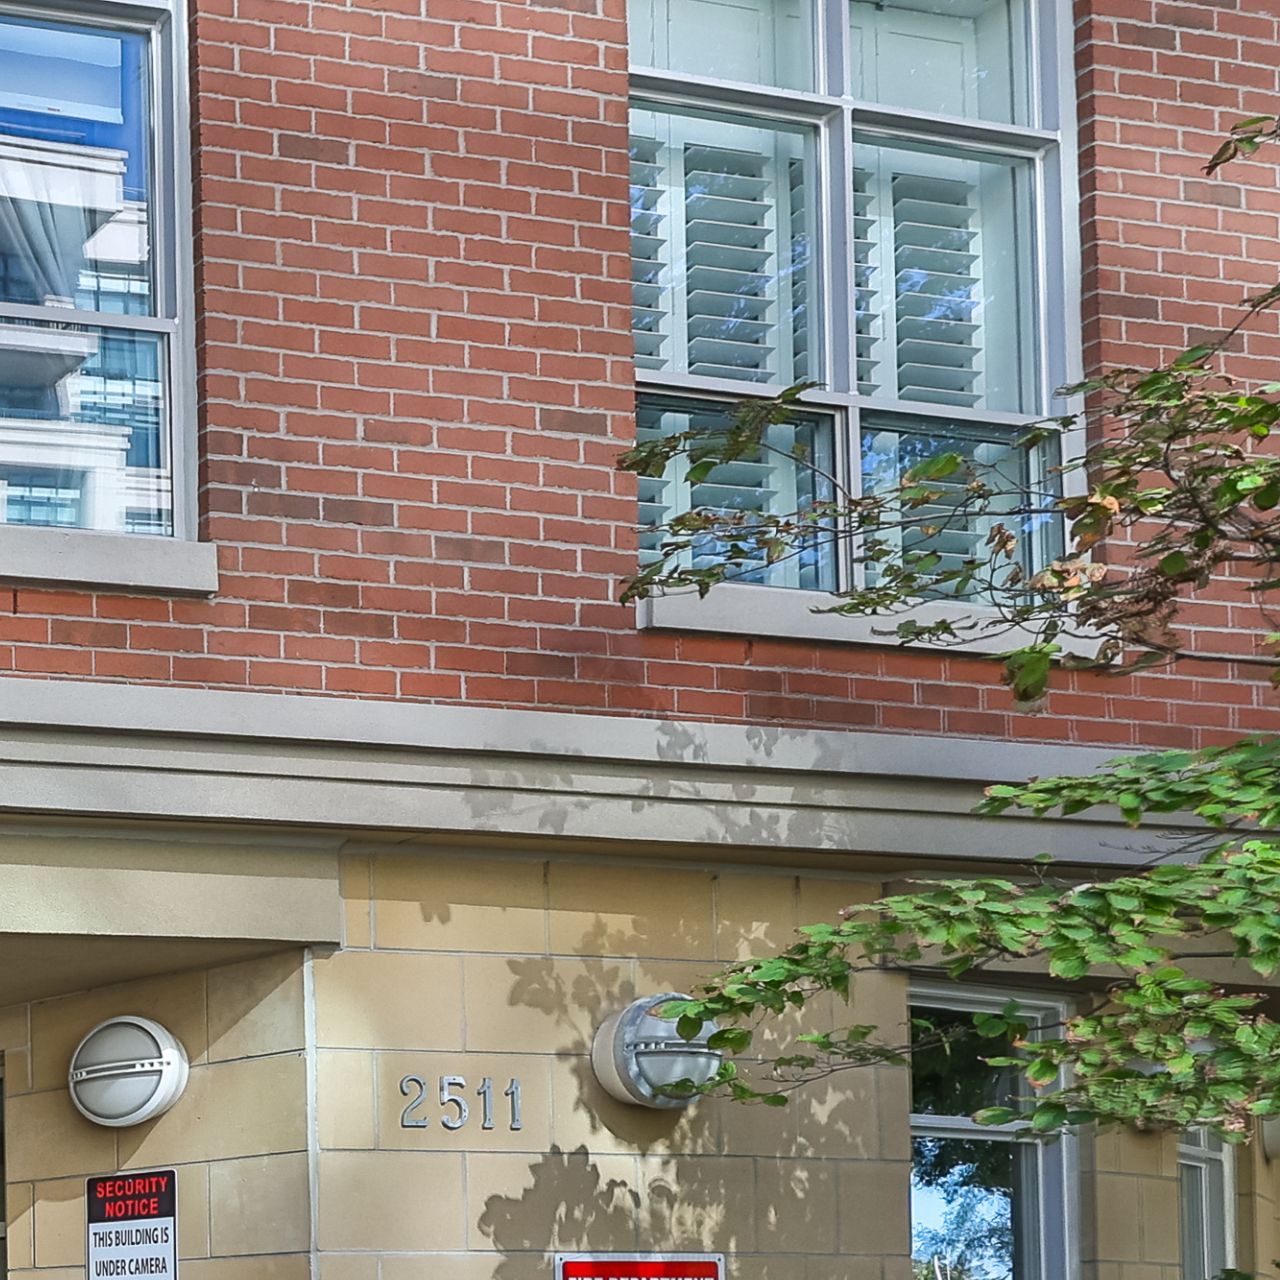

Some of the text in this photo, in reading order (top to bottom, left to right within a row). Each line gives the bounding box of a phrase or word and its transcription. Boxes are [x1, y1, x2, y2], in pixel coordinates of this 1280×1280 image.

[399, 1074, 523, 1131] 2511
[96, 1176, 169, 1198] SECURITY
[105, 1197, 159, 1218] NOTICE
[93, 1226, 170, 1248] THIS BUILDING IS
[95, 1256, 168, 1277] UNDER CAMERA
